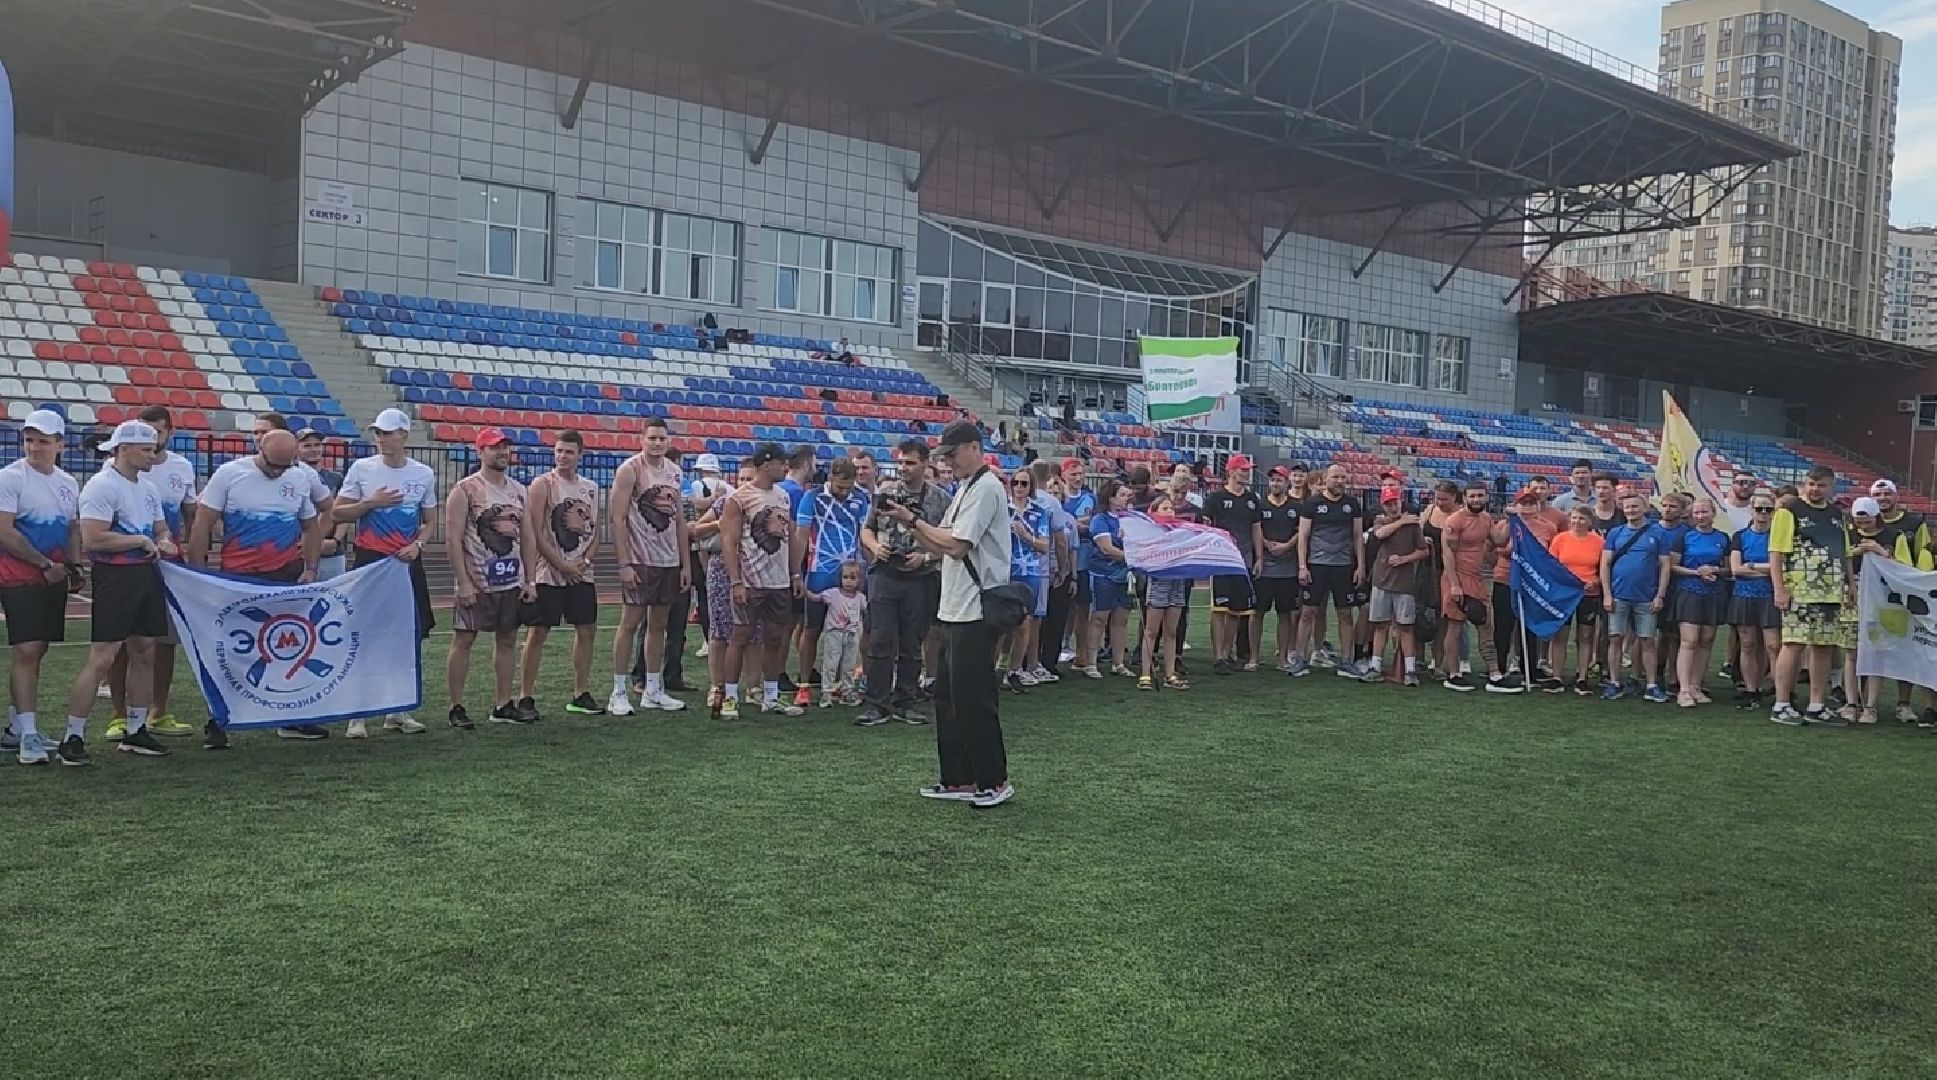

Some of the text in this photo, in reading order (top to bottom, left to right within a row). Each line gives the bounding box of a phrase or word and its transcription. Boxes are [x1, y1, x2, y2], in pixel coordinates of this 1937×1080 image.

[309, 208, 349, 221] СЕКТОР
[495, 561, 516, 576] 94
[215, 640, 243, 692] ПЕРВИЧНАЯ
[241, 690, 322, 710] ПРОФСОЮЗНАЯ
